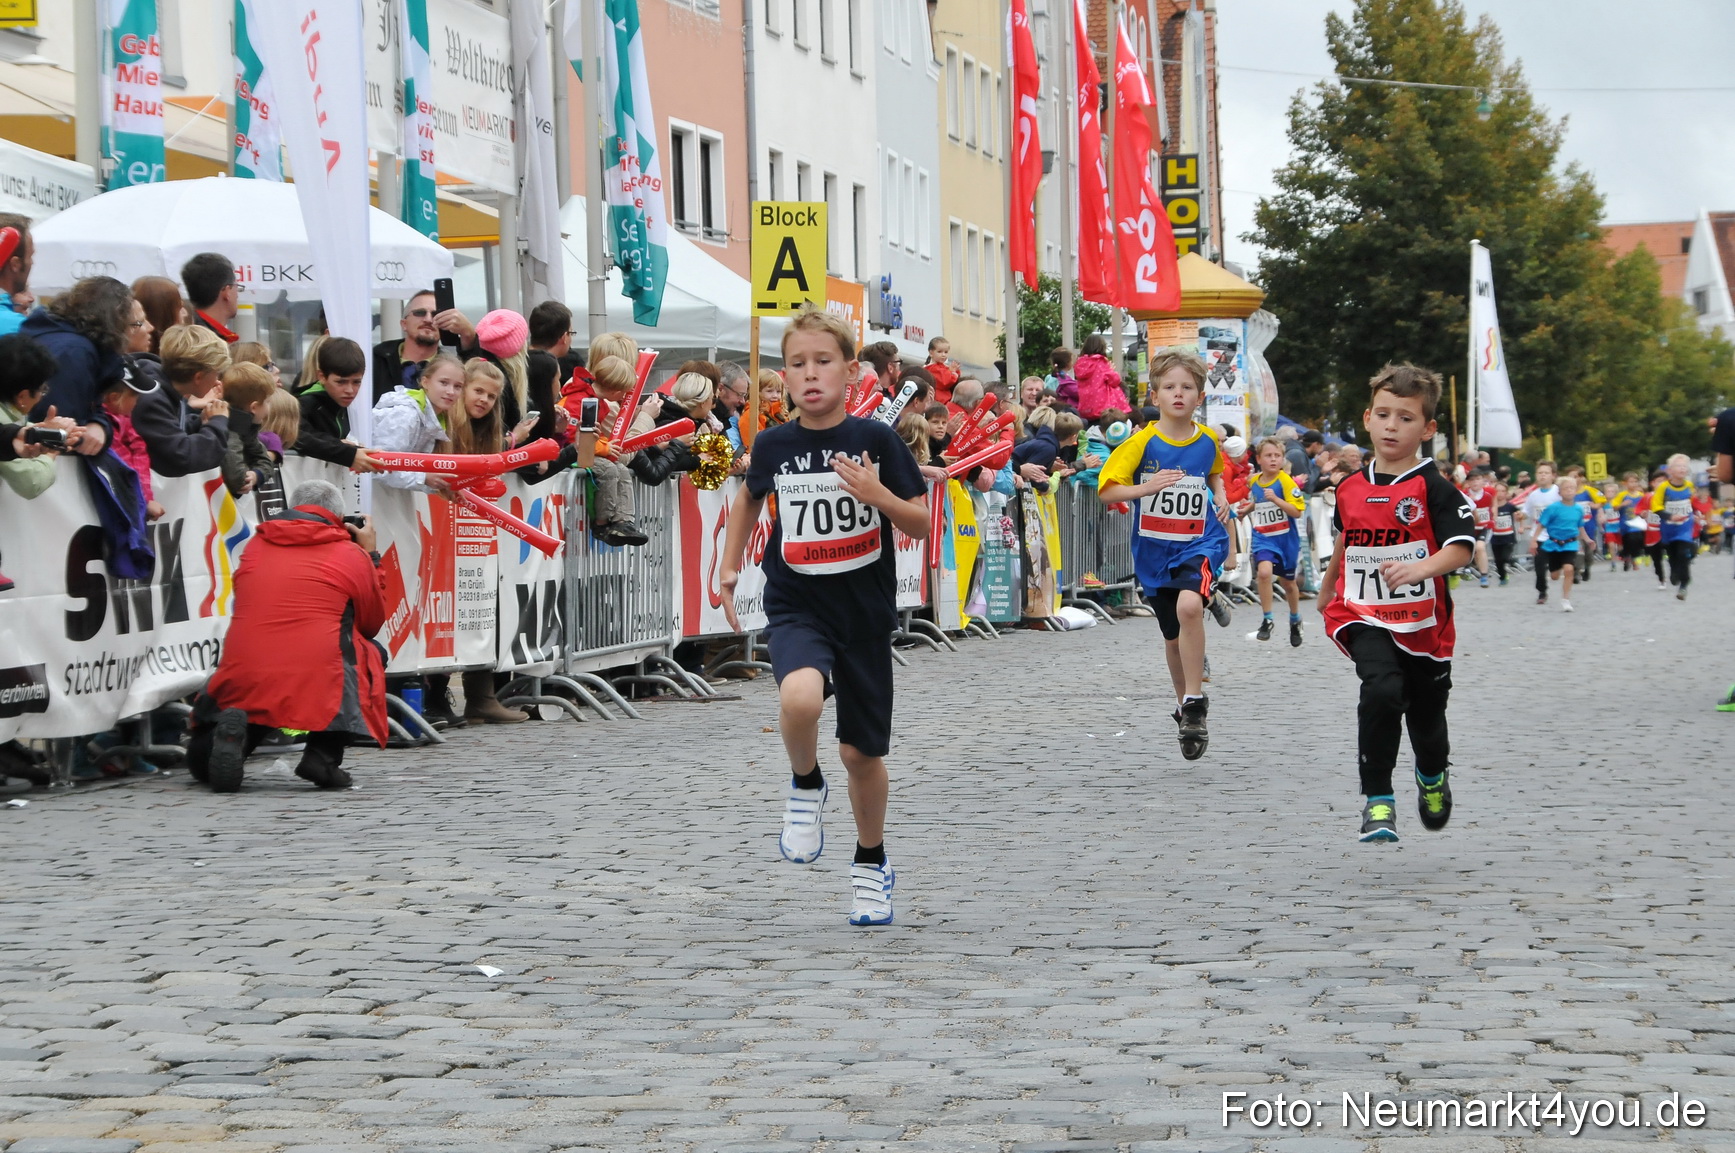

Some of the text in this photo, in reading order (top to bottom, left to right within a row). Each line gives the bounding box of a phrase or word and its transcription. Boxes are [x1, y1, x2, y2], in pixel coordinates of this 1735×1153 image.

[120, 34, 160, 57] Geb
[116, 63, 160, 86] Mie
[114, 92, 163, 118] Haus
[462, 104, 509, 140] NEUMARKT
[29, 182, 54, 209] Audi
[1166, 158, 1198, 255] HOT
[760, 206, 818, 227] Block
[261, 264, 314, 281] BKK
[766, 236, 810, 292] A
[886, 398, 904, 422] BMW
[957, 441, 971, 452] Audi
[404, 458, 425, 467] BKK
[781, 484, 814, 494] PARTL
[1150, 491, 1203, 516] 7509
[485, 511, 528, 539] Audi BKK
[790, 496, 873, 536] 7093
[1257, 508, 1285, 525] 7109
[803, 542, 867, 561] Johannes
[1346, 555, 1369, 564] PARTL
[459, 567, 474, 577] Braun
[458, 621, 467, 631] Fax
[1374, 608, 1409, 621] Aaron
[146, 633, 221, 673] neuma
